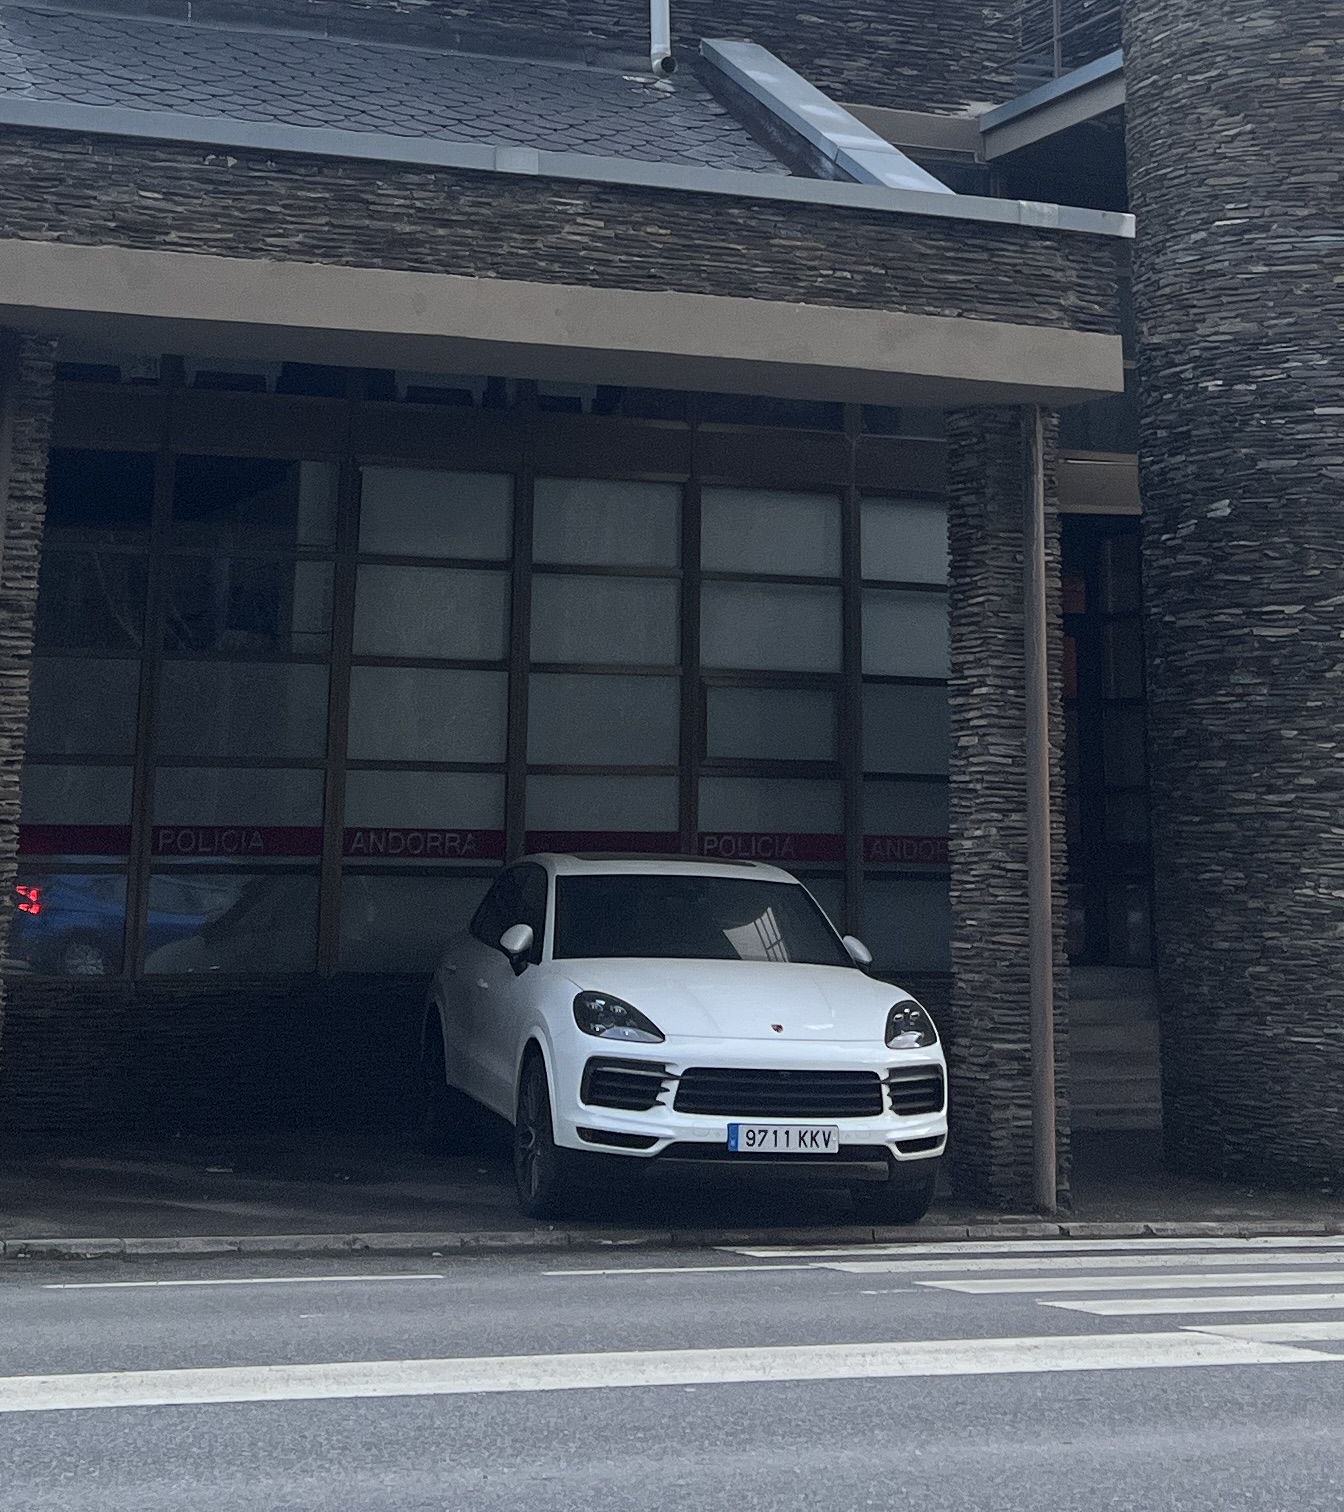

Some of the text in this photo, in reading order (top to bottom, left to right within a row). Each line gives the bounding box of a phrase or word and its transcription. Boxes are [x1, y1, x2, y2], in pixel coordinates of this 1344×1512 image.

[158, 829, 265, 853] POLICIA
[351, 831, 478, 854] ANDORRA
[704, 835, 796, 859] POLICIA
[745, 1129, 790, 1148] 9711
[798, 1130, 832, 1148] KKV
